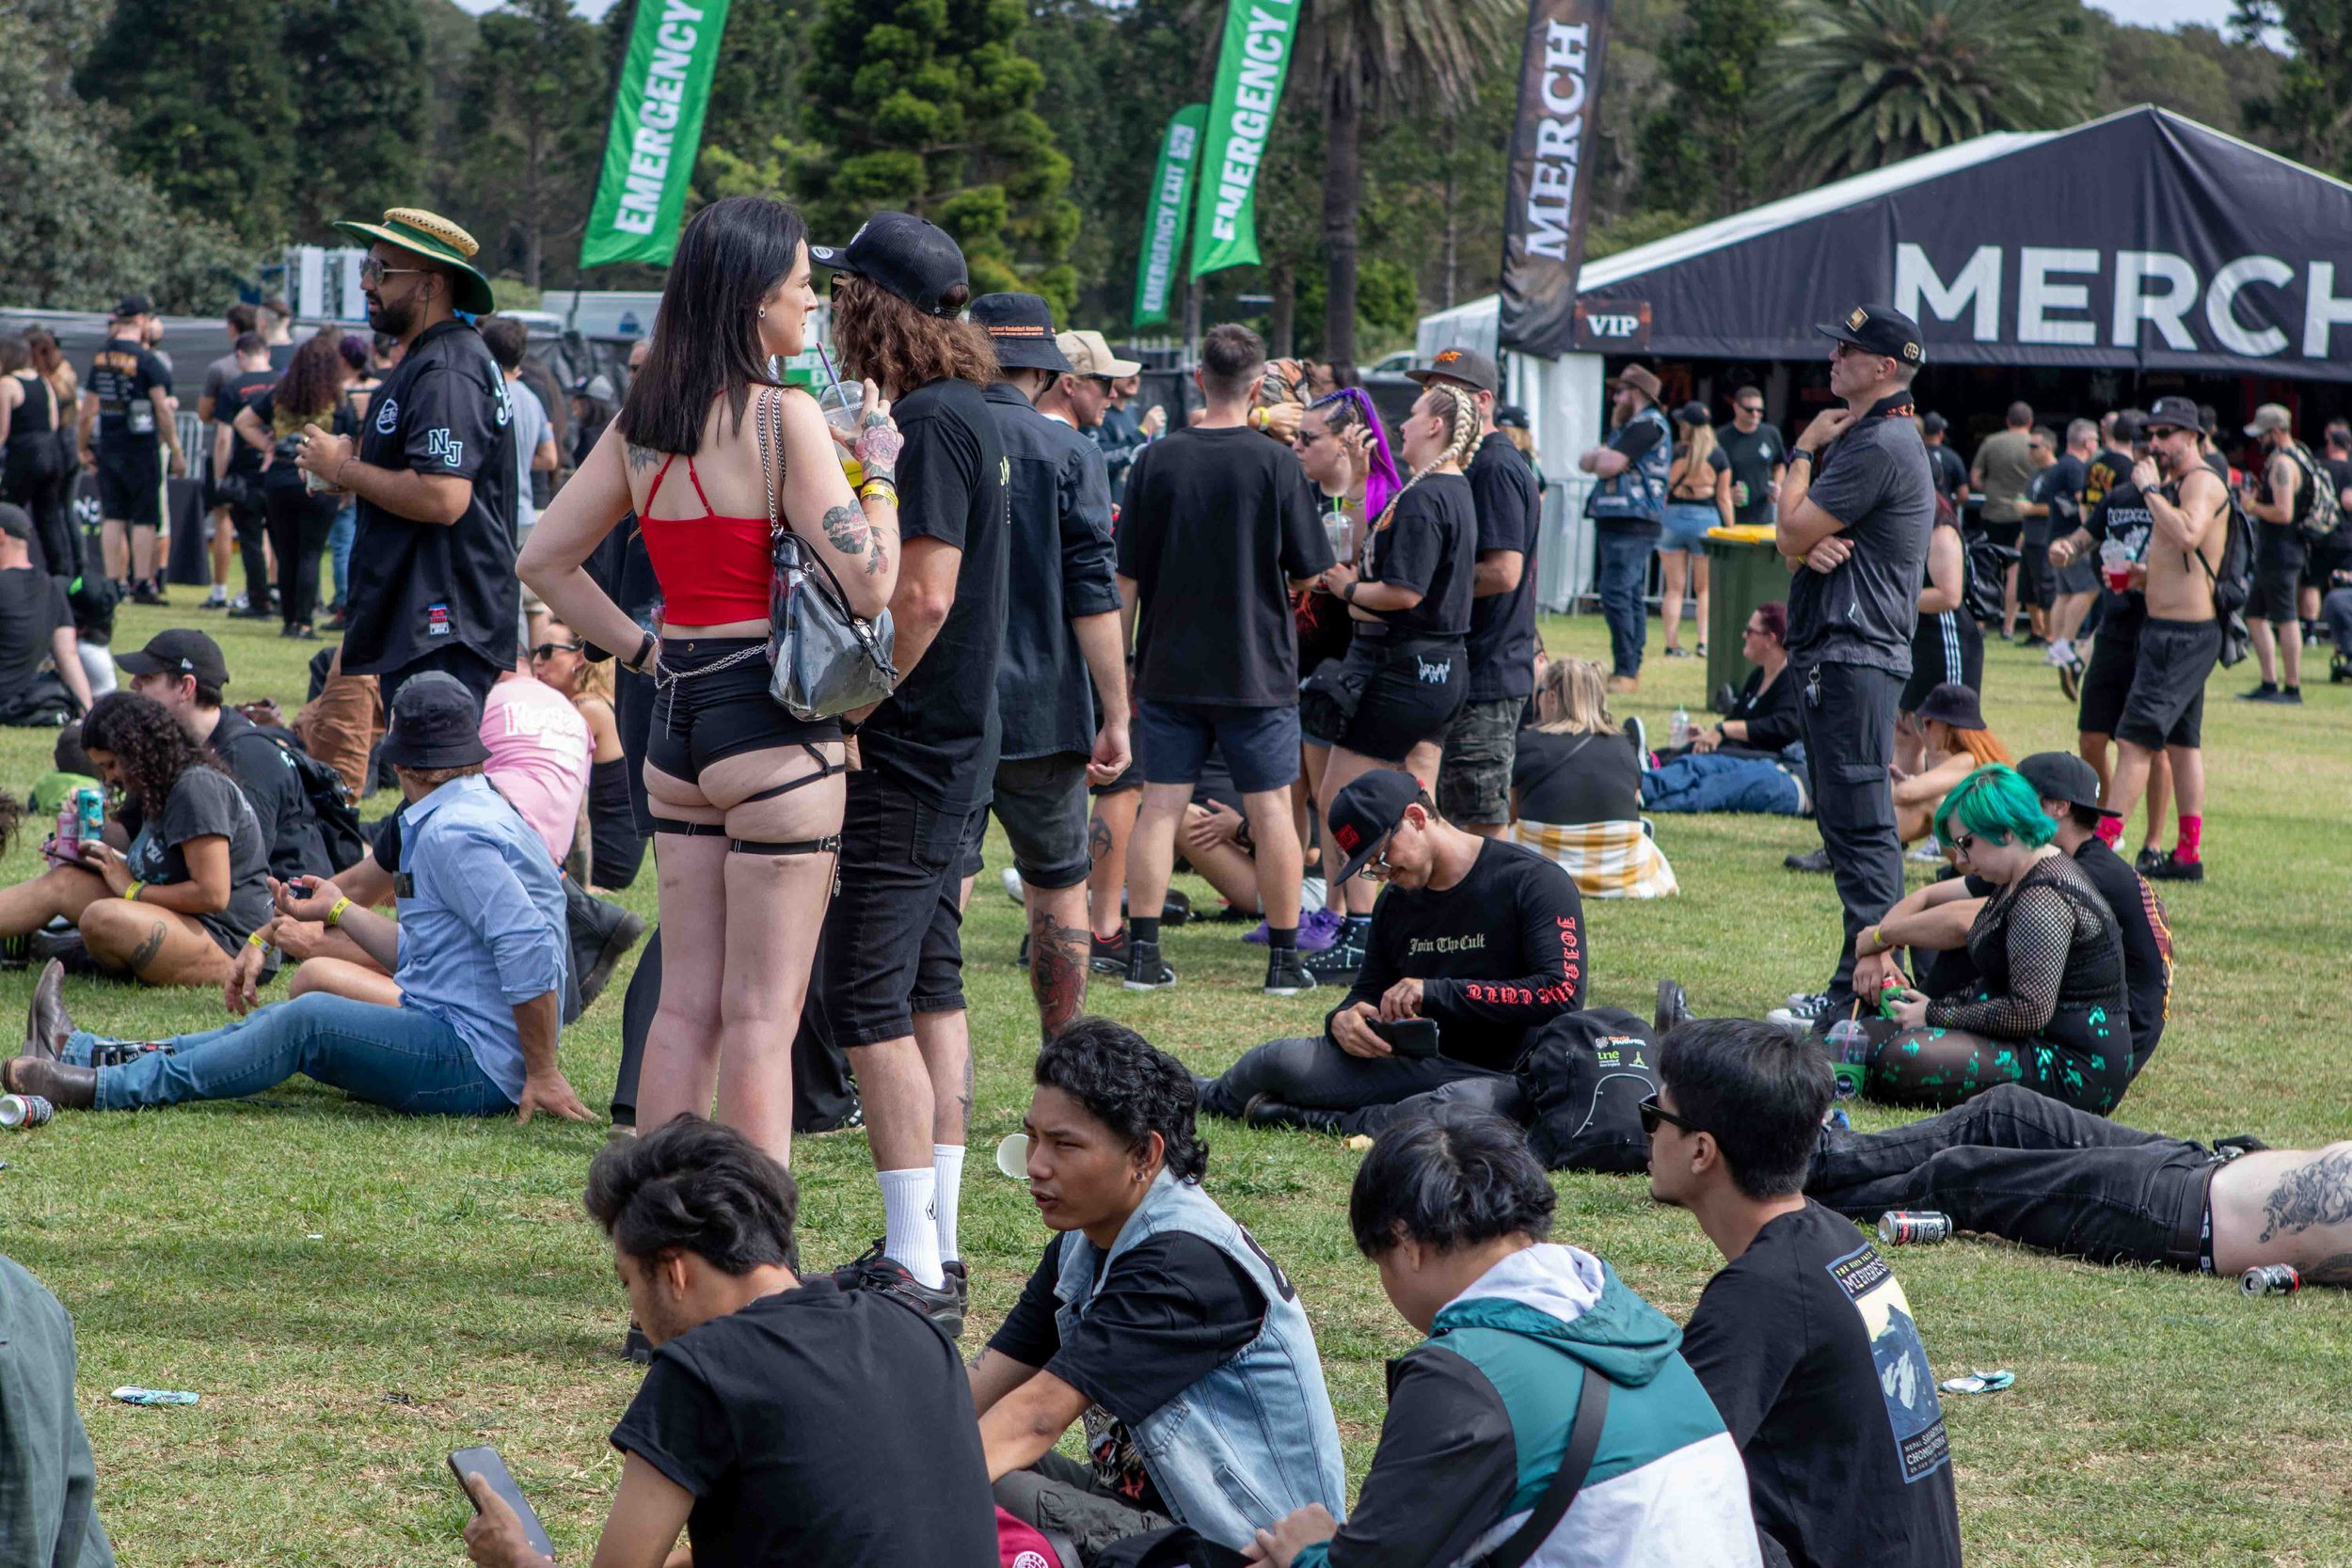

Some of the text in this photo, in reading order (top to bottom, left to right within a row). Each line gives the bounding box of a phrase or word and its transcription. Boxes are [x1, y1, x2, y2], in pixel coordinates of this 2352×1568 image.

[613, 0, 705, 235] EMERGENCY
[1524, 18, 1589, 262] MERCH
[1585, 314, 1640, 338] VIP
[1408, 933, 1486, 956] Join The Cult
